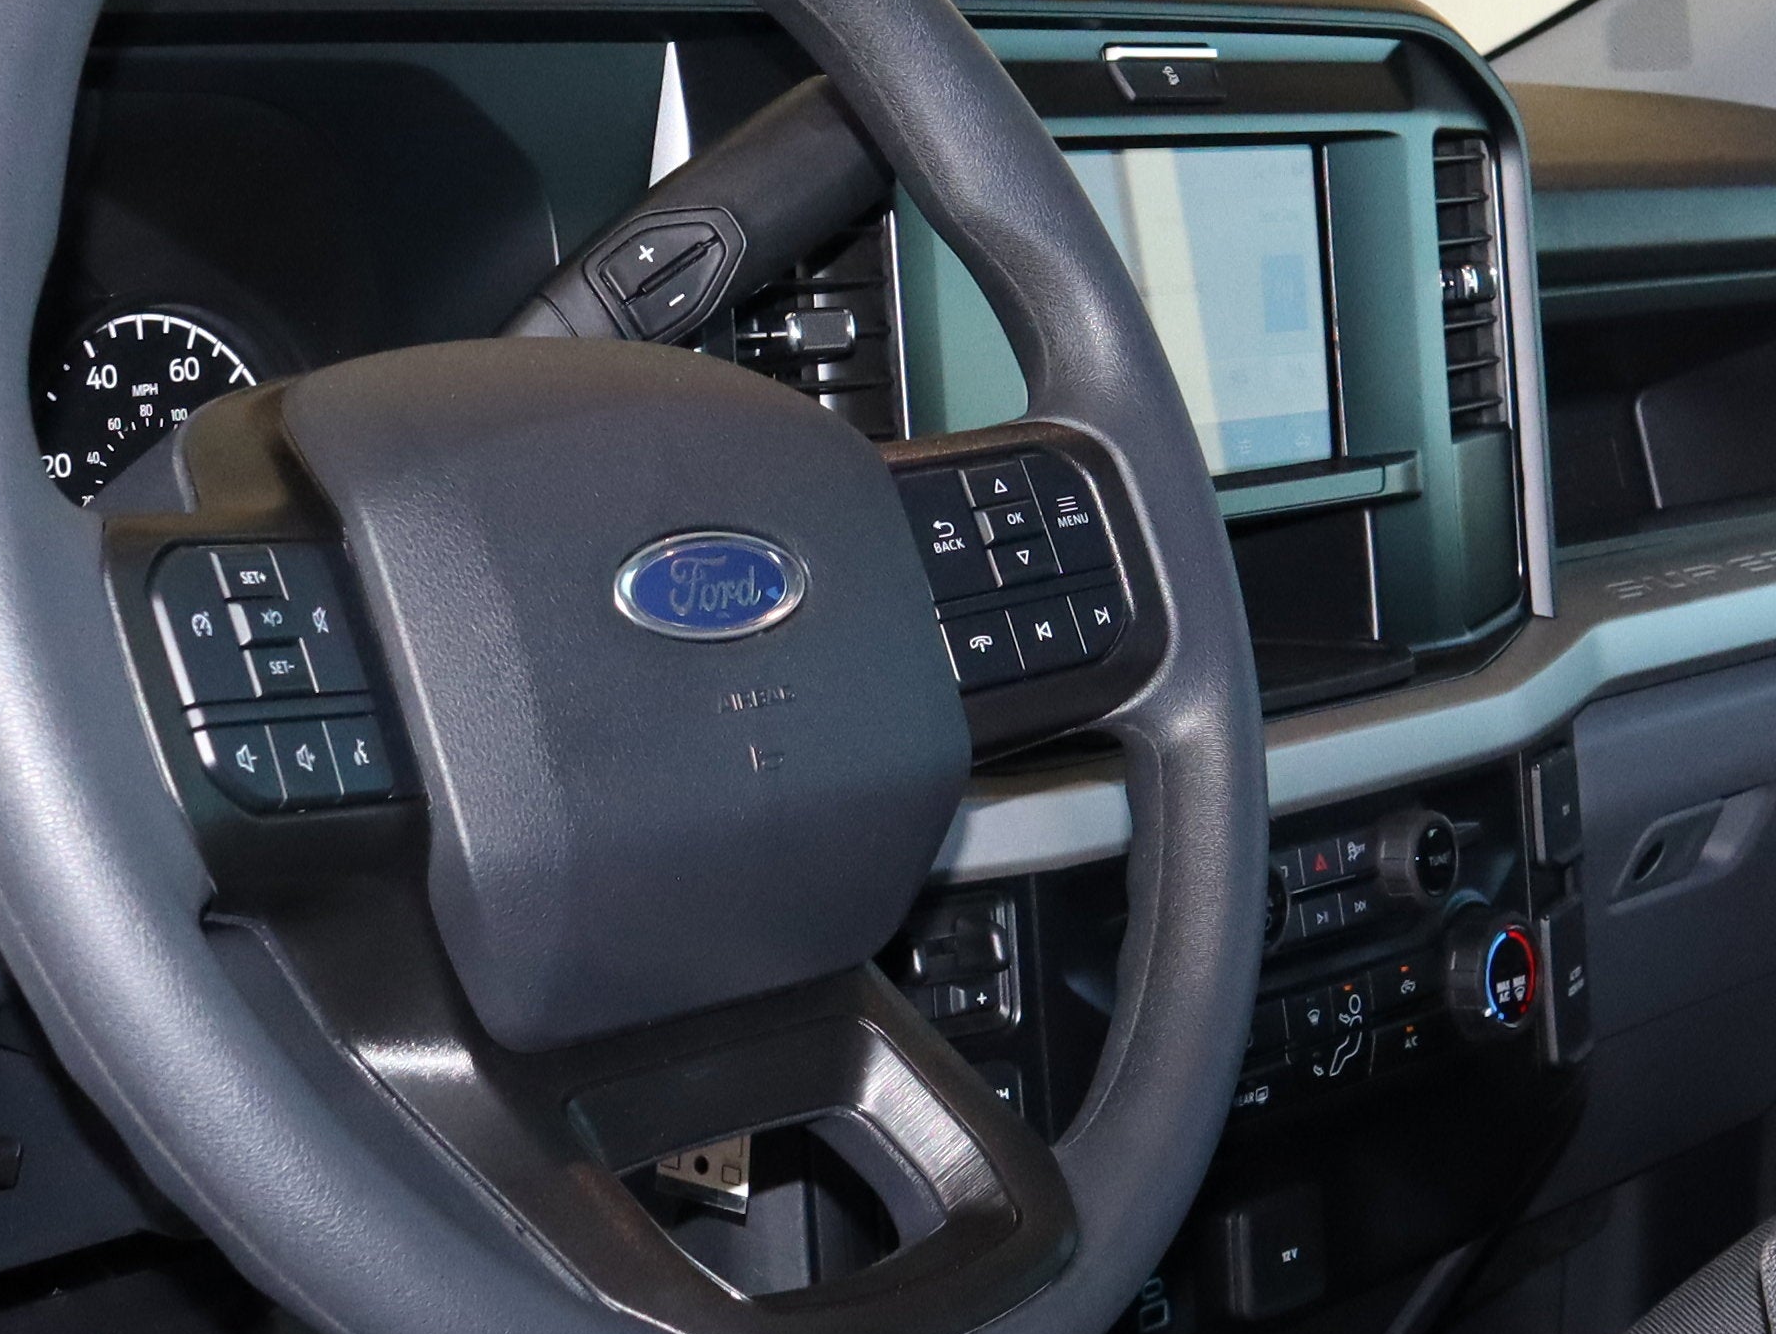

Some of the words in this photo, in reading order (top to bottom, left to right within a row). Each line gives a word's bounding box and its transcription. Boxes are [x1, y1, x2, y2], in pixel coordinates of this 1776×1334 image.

[86, 365, 118, 390] 40
[169, 356, 200, 383] 60
[132, 383, 159, 397] MPH
[139, 404, 153, 417] 80
[171, 408, 187, 422] 100
[107, 417, 122, 431] 60
[41, 453, 71, 479] 20
[86, 451, 100, 465] 40
[1006, 511, 1025, 526] OK
[1057, 512, 1089, 529] MENU
[933, 537, 966, 554] BACK
[669, 555, 762, 616] Ford
[1282, 1247, 1298, 1263] 12V
